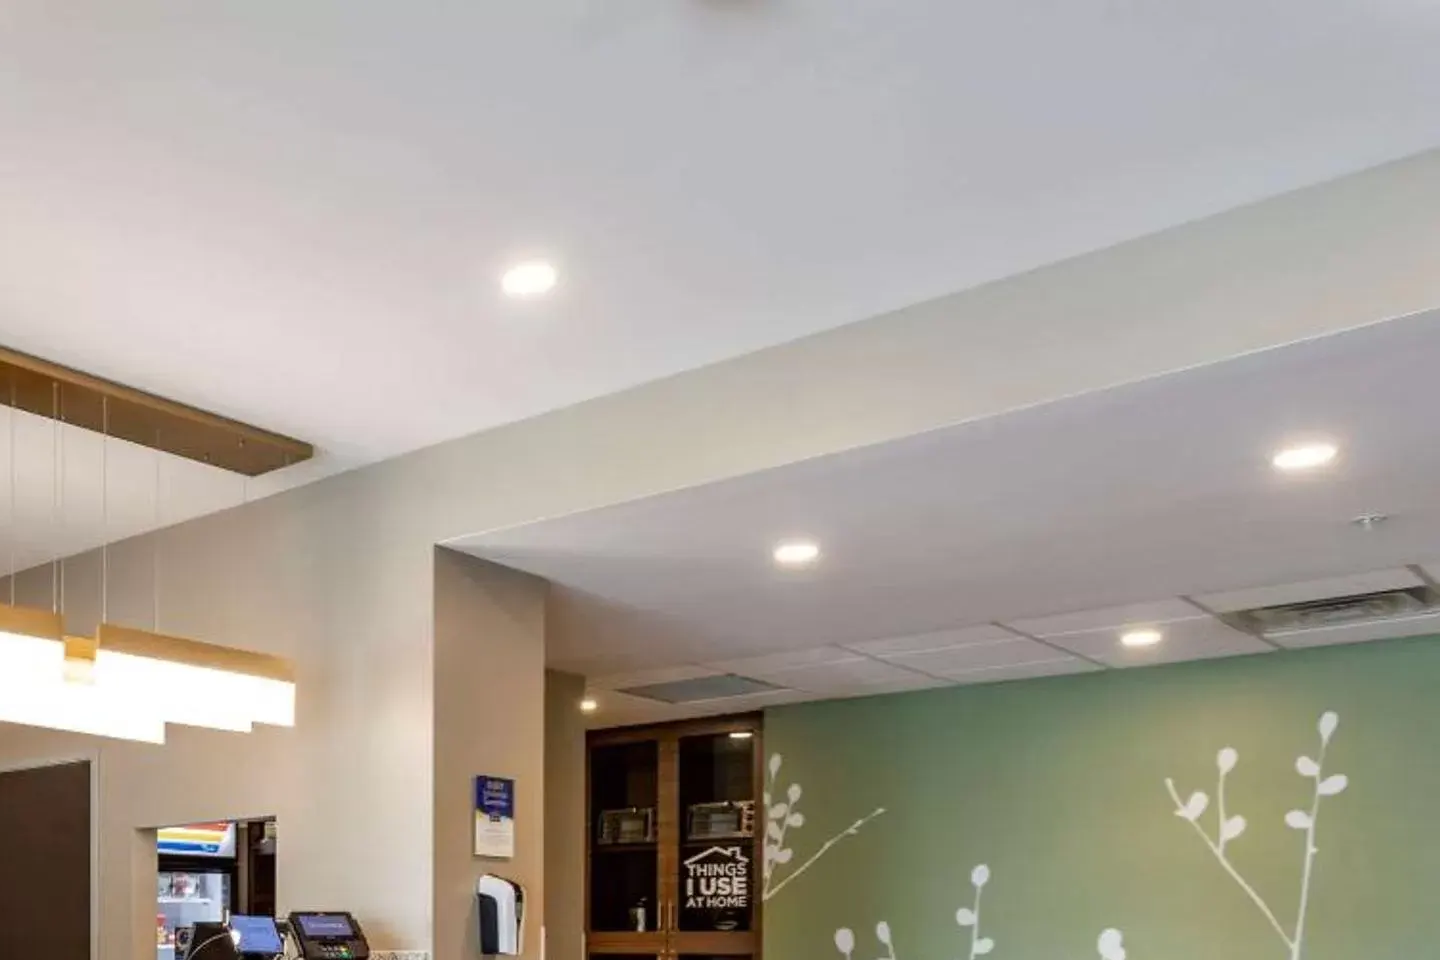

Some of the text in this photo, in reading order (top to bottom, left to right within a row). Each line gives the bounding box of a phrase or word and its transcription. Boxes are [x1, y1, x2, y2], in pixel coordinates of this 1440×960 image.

[687, 863, 747, 876] THINGS
[687, 877, 747, 896] I USE
[686, 896, 747, 908] AT HOME
